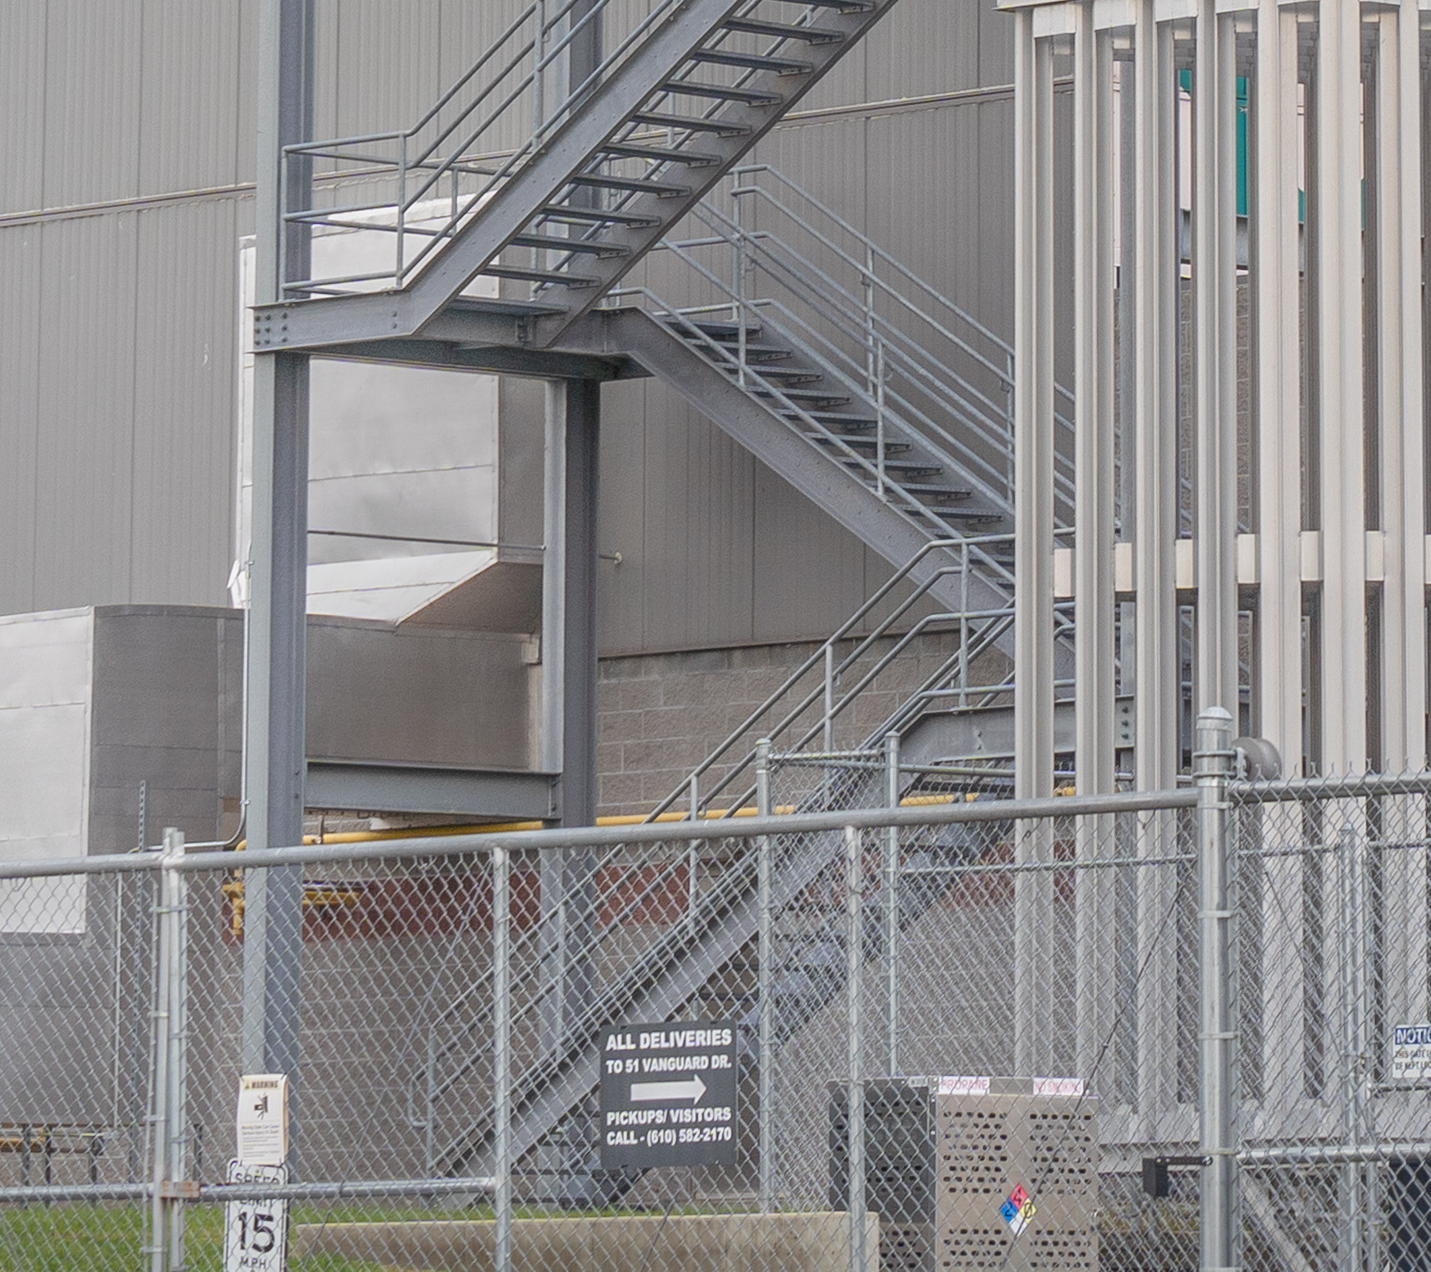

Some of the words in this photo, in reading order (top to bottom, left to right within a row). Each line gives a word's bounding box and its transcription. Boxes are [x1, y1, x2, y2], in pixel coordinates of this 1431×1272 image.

[606, 1033, 636, 1051] ALL
[639, 1029, 732, 1049] DELIVERIES
[606, 1060, 623, 1074] TO
[625, 1058, 640, 1073] 51
[642, 1055, 709, 1072] VANGUARD
[711, 1054, 732, 1069] DR.
[941, 1079, 988, 1090] PROPANE
[670, 1107, 732, 1123] VISITORS
[606, 1130, 638, 1146] CALL
[646, 1129, 676, 1147] (610)
[679, 1126, 732, 1143] 582-2170
[238, 1212, 275, 1253] 15
